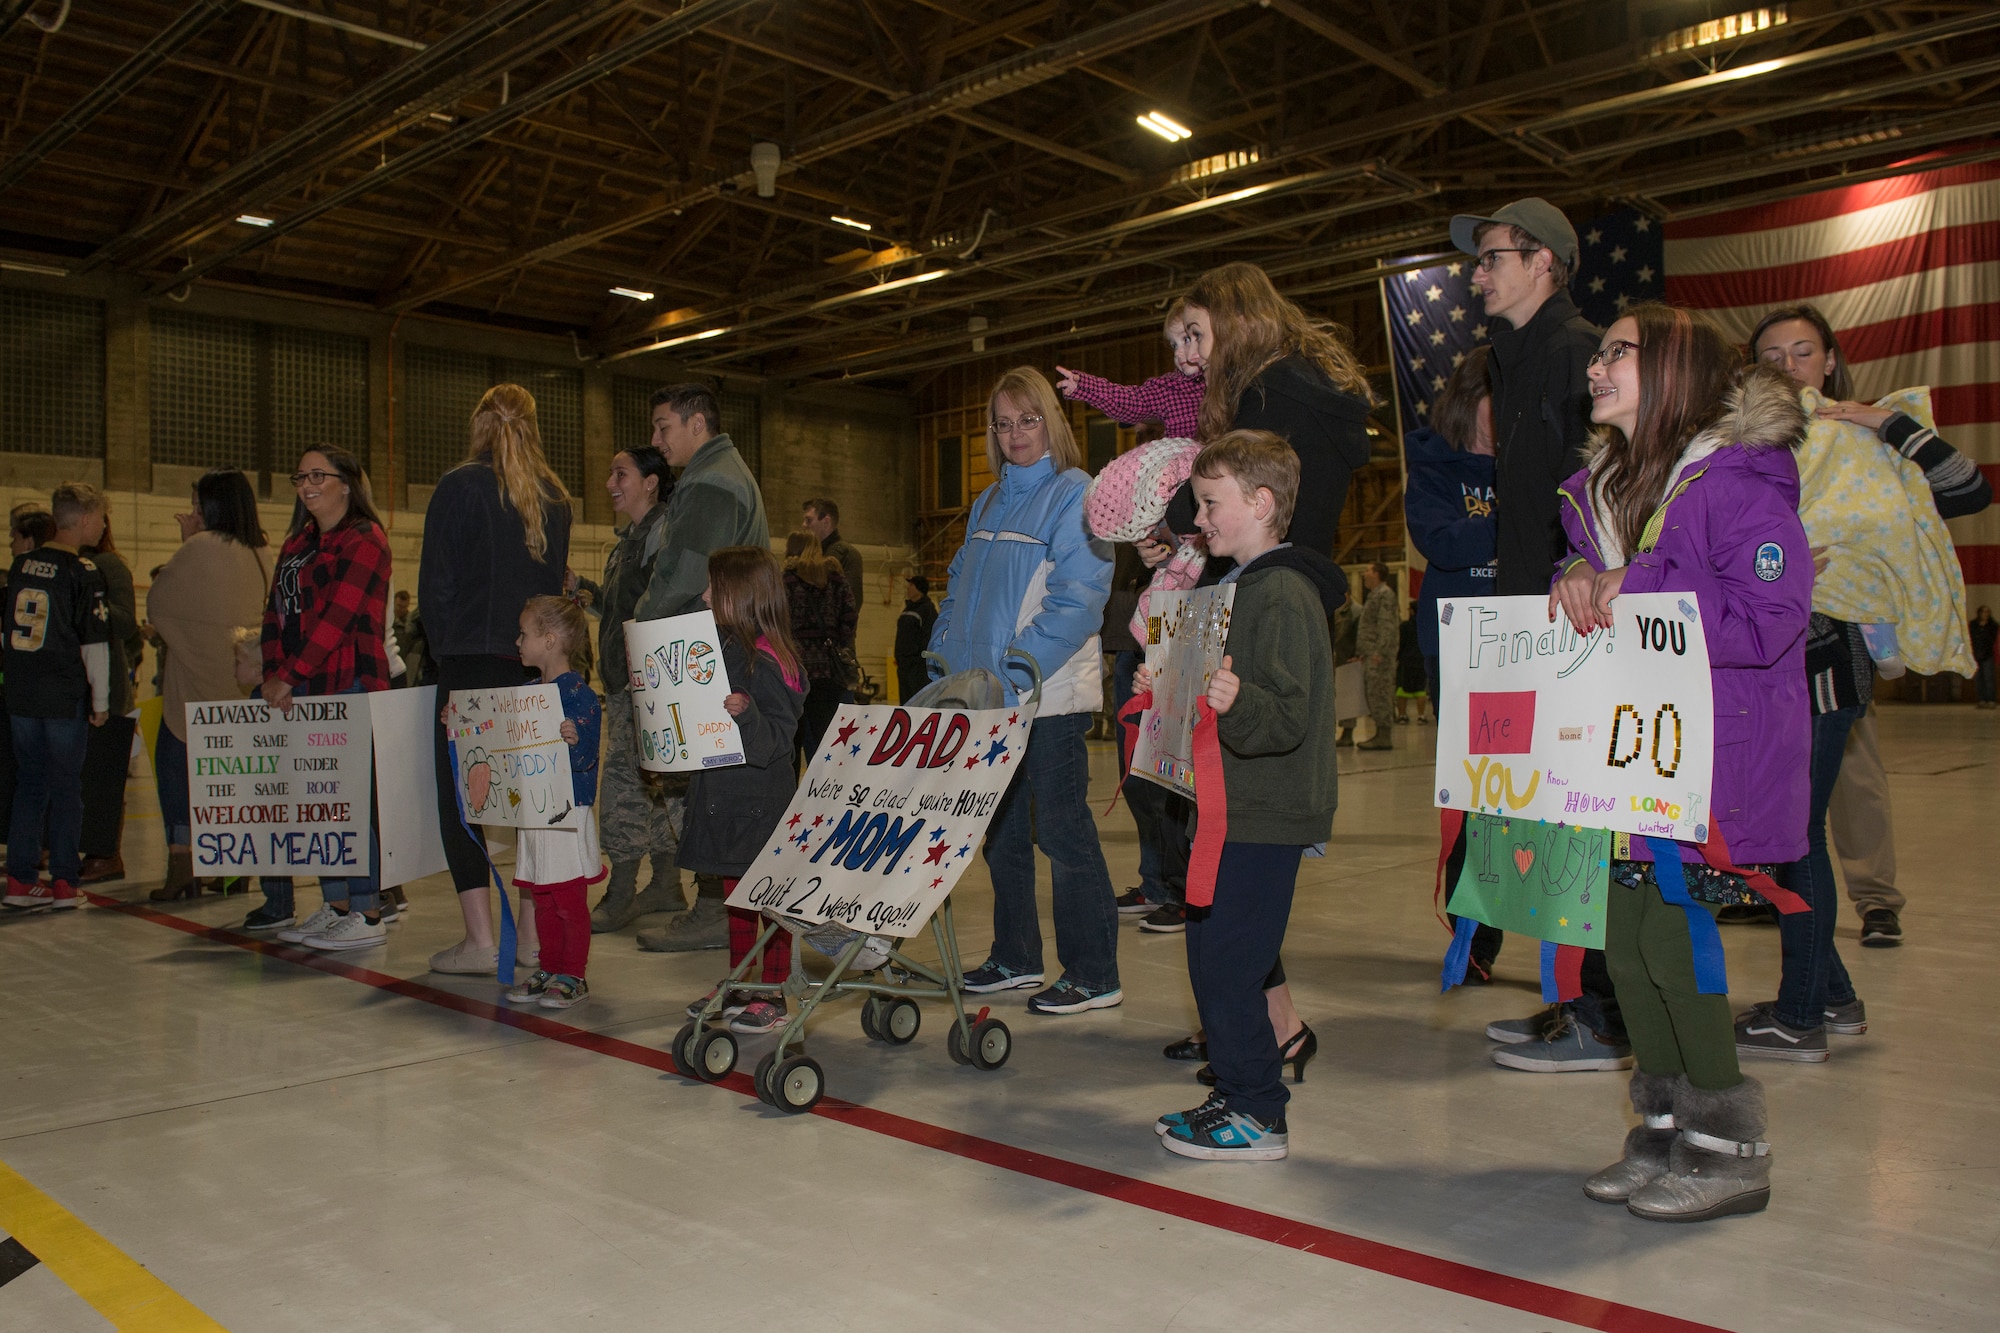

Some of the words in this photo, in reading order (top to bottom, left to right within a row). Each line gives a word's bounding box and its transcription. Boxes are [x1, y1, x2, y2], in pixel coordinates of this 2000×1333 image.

[21, 559, 59, 579] BREES
[11, 588, 50, 652] 9
[1636, 615, 1687, 656] YOU
[192, 704, 271, 725] ALWAYS
[283, 702, 348, 722] UNDER
[497, 691, 550, 714] Welcome
[204, 735, 233, 748] THE
[253, 734, 288, 748] SAME
[307, 733, 347, 747] STARS
[507, 719, 542, 744] HOME
[697, 721, 732, 736] DADDY
[867, 708, 970, 772] DAD,
[1476, 710, 1511, 746] Are
[1559, 731, 1581, 741] home
[1607, 703, 1682, 779] DO
[196, 755, 280, 775] FINALLY
[293, 758, 338, 771] UNDER
[507, 752, 558, 778] DADDY
[206, 784, 236, 797] THE
[254, 783, 289, 796] SAME
[306, 781, 340, 794] ROOF
[807, 778, 843, 800] We're
[872, 786, 914, 809] Glad
[911, 792, 952, 816] you're
[951, 790, 999, 818] HOME!
[1463, 756, 1541, 811] YOU
[192, 804, 289, 824] WELCOME
[296, 803, 350, 823] HOME
[1564, 791, 1616, 813] HOW
[1630, 796, 1682, 820] LONG
[197, 832, 258, 866] SRA
[271, 832, 357, 866] MEADE
[809, 809, 926, 875] MOM
[1478, 813, 1502, 883] I
[749, 876, 796, 907] Quit
[786, 876, 821, 914] 2
[866, 901, 921, 931] ago!!!
